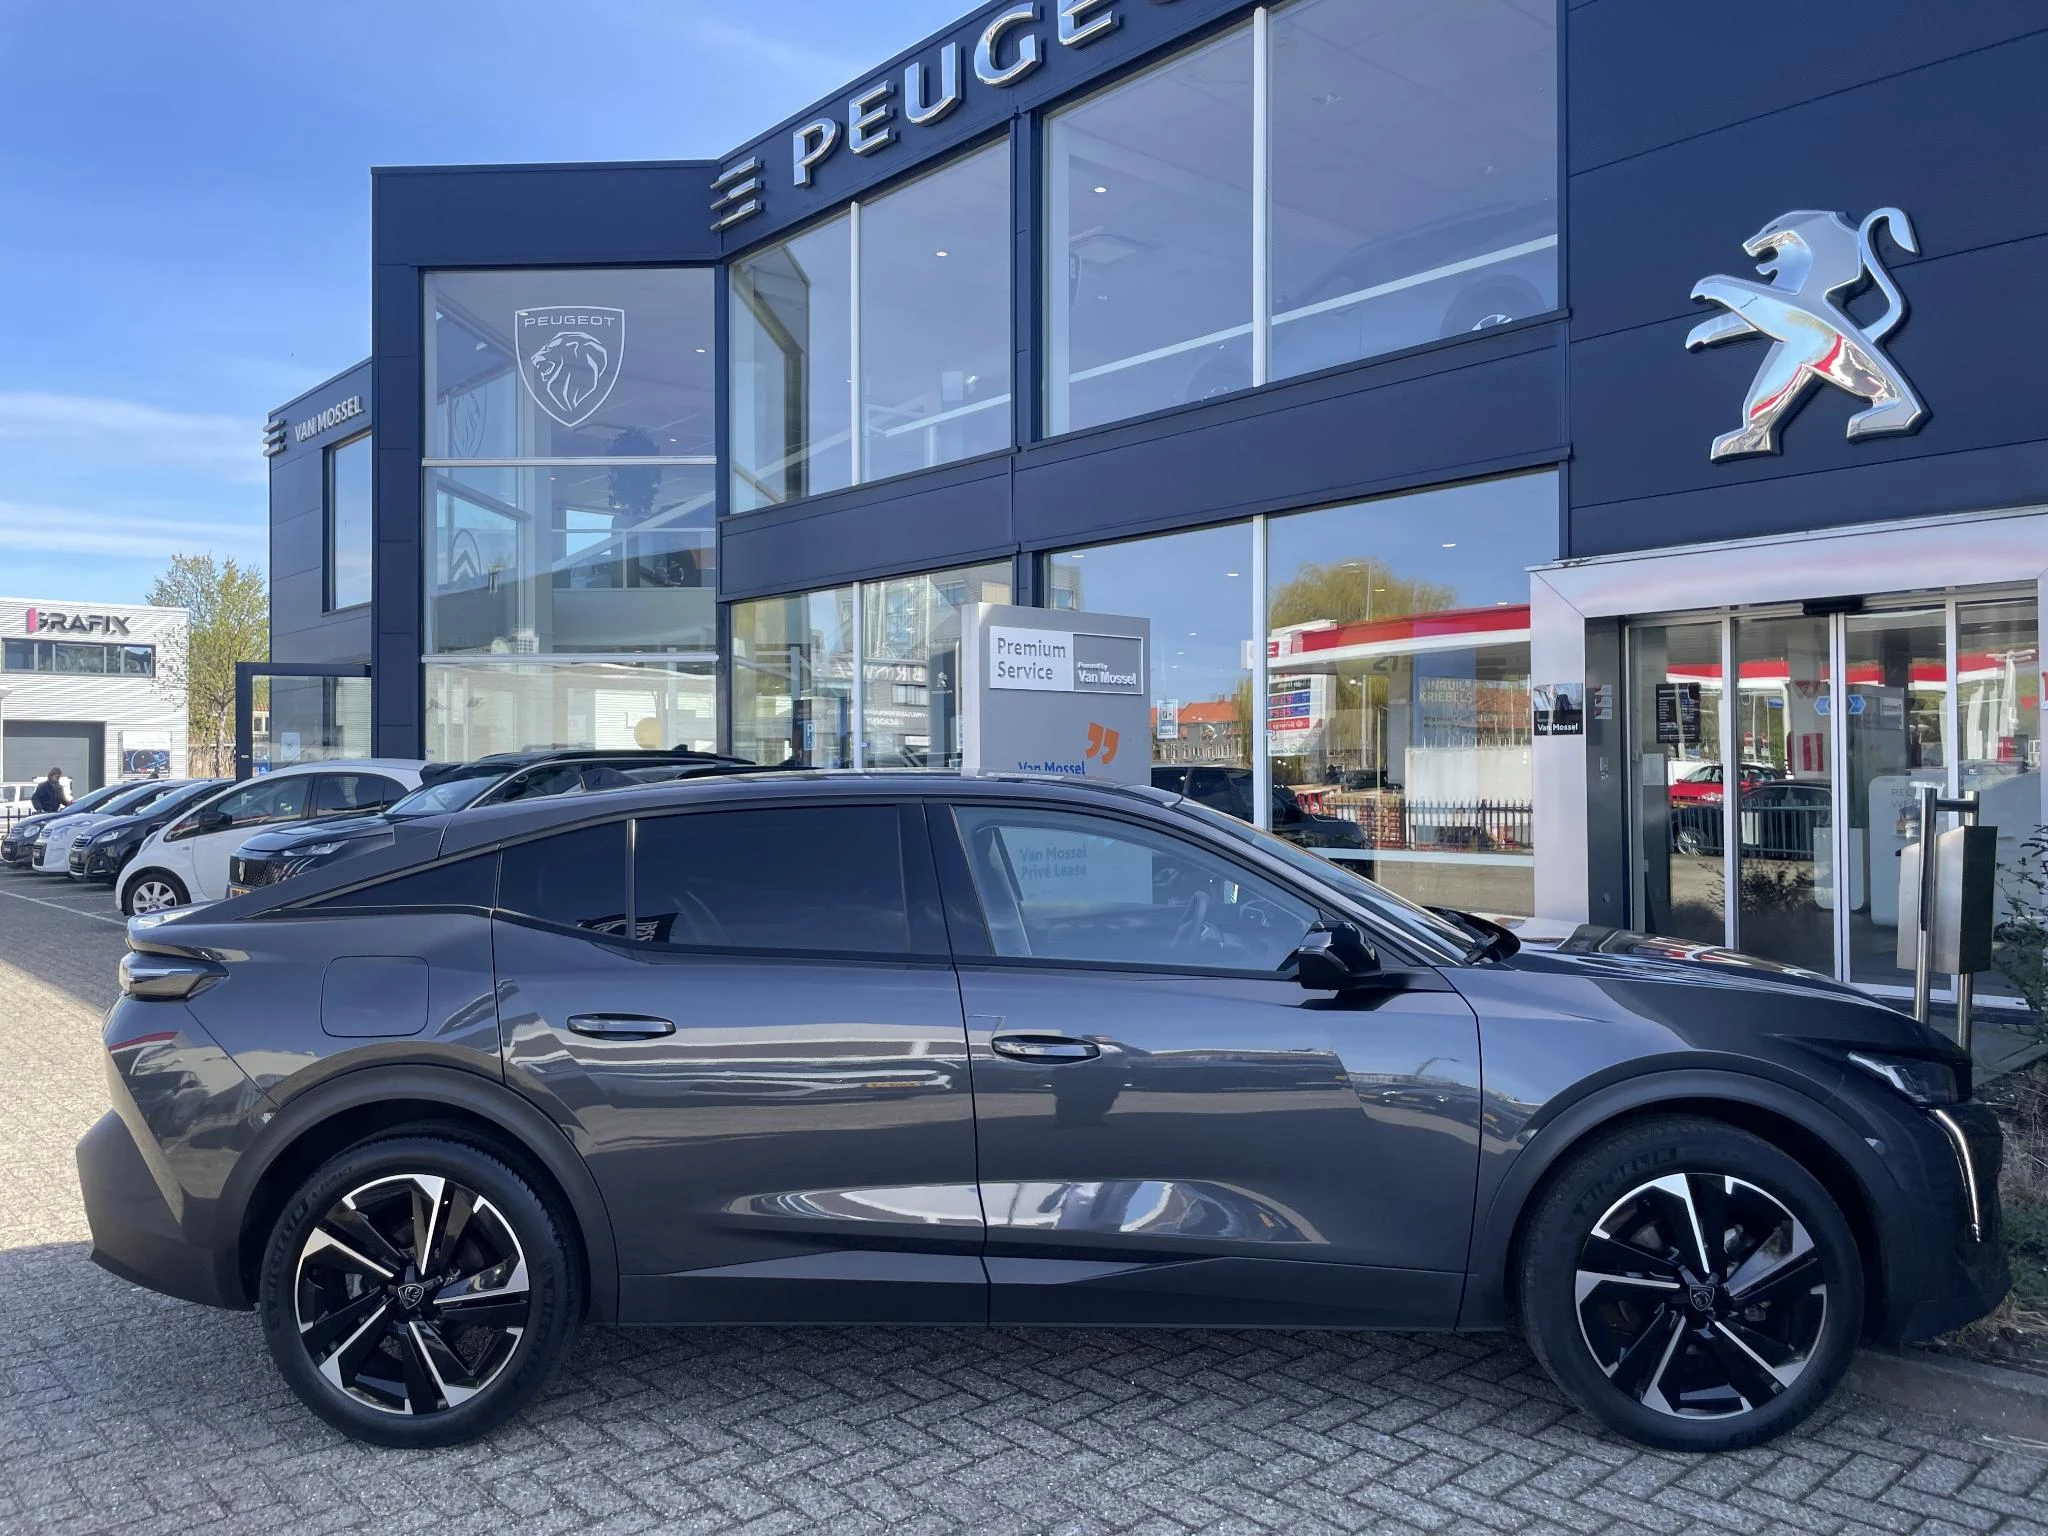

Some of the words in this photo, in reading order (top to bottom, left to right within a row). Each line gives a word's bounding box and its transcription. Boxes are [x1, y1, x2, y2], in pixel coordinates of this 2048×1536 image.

[793, 0, 1184, 187] PEUGE
[524, 315, 616, 328] PEUGEOT
[294, 416, 317, 442] VAN
[317, 395, 364, 432] MOSSEL
[997, 637, 1066, 659] Premium
[997, 660, 1053, 681] Service
[1077, 670, 1098, 683] Van
[1100, 671, 1137, 685] Mossel
[1537, 724, 1551, 732] Van
[1552, 723, 1578, 731] Mossel
[1019, 847, 1043, 862] Van
[1045, 844, 1088, 861] Mossel
[1054, 863, 1088, 877] Lease
